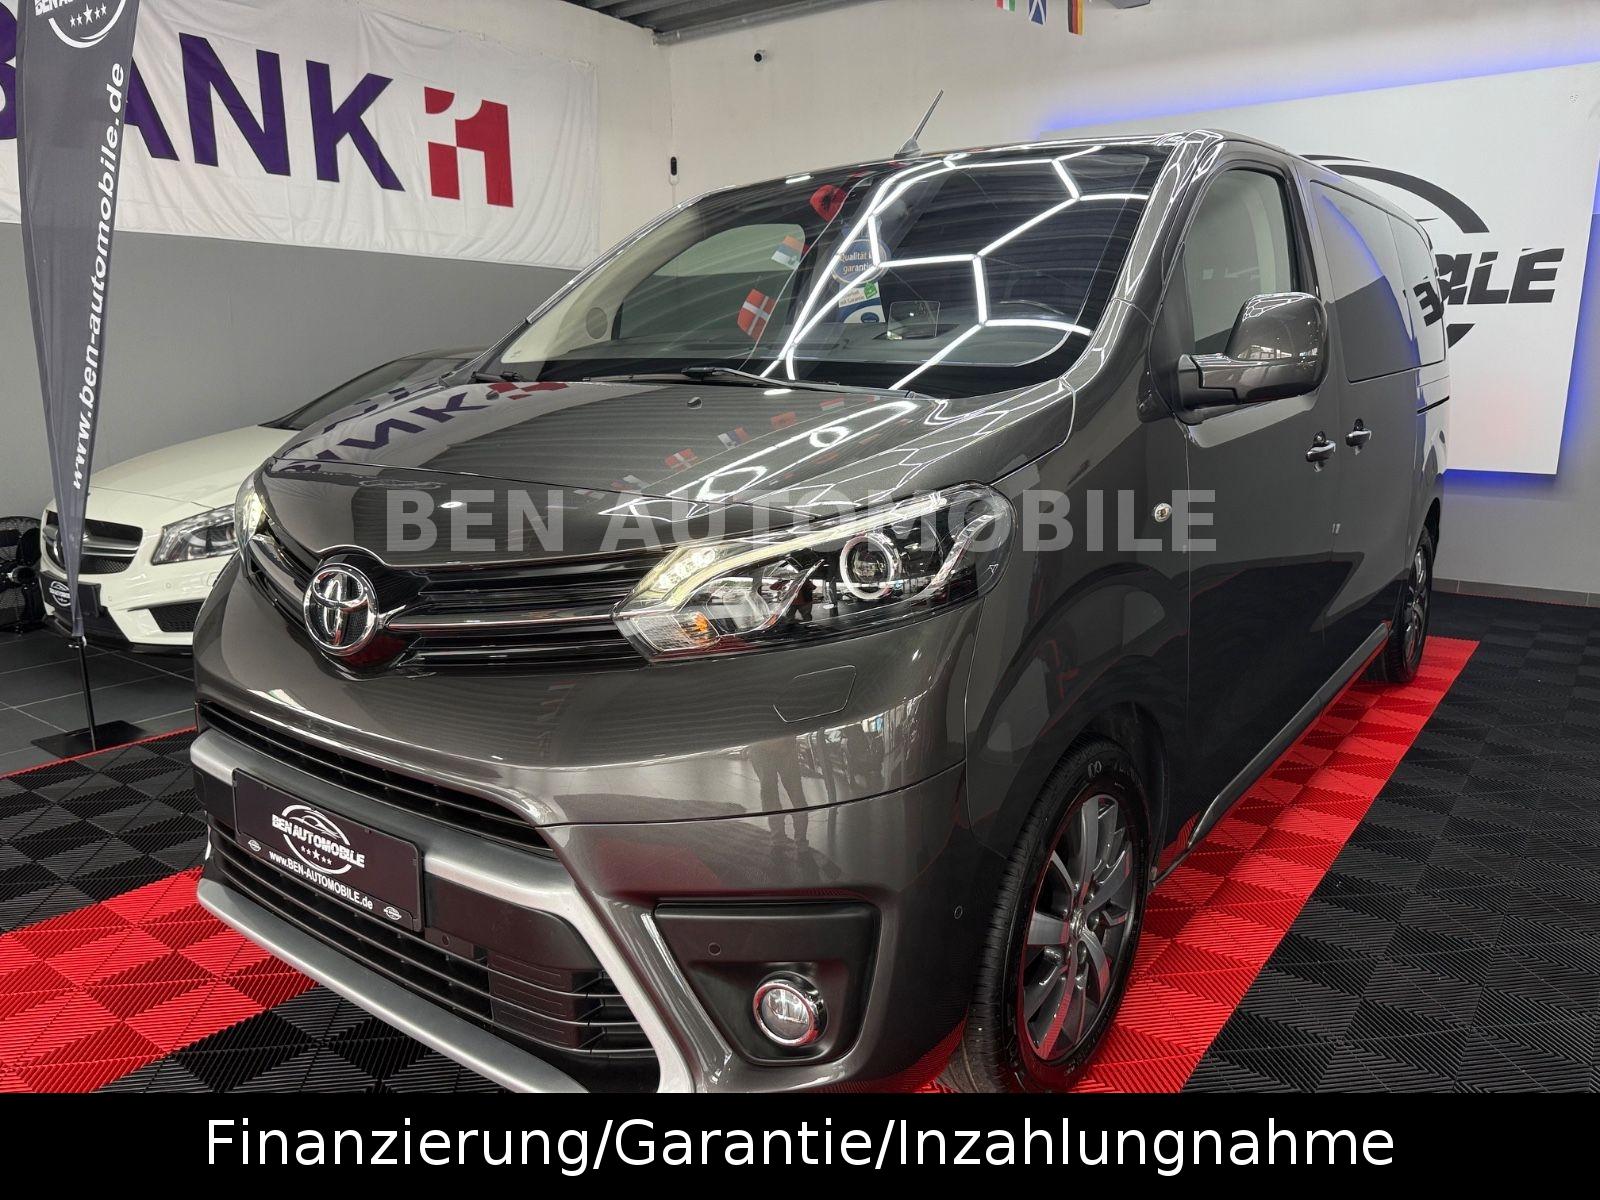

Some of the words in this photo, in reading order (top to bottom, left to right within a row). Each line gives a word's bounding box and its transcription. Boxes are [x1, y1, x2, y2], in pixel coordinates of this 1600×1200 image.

[73, 62, 124, 490] www.ben-automobile.de
[272, 814, 293, 835] BEN
[292, 825, 365, 868] AUTOMOBILE
[269, 851, 373, 910] www.BEN-AUTOMOBILE.de
